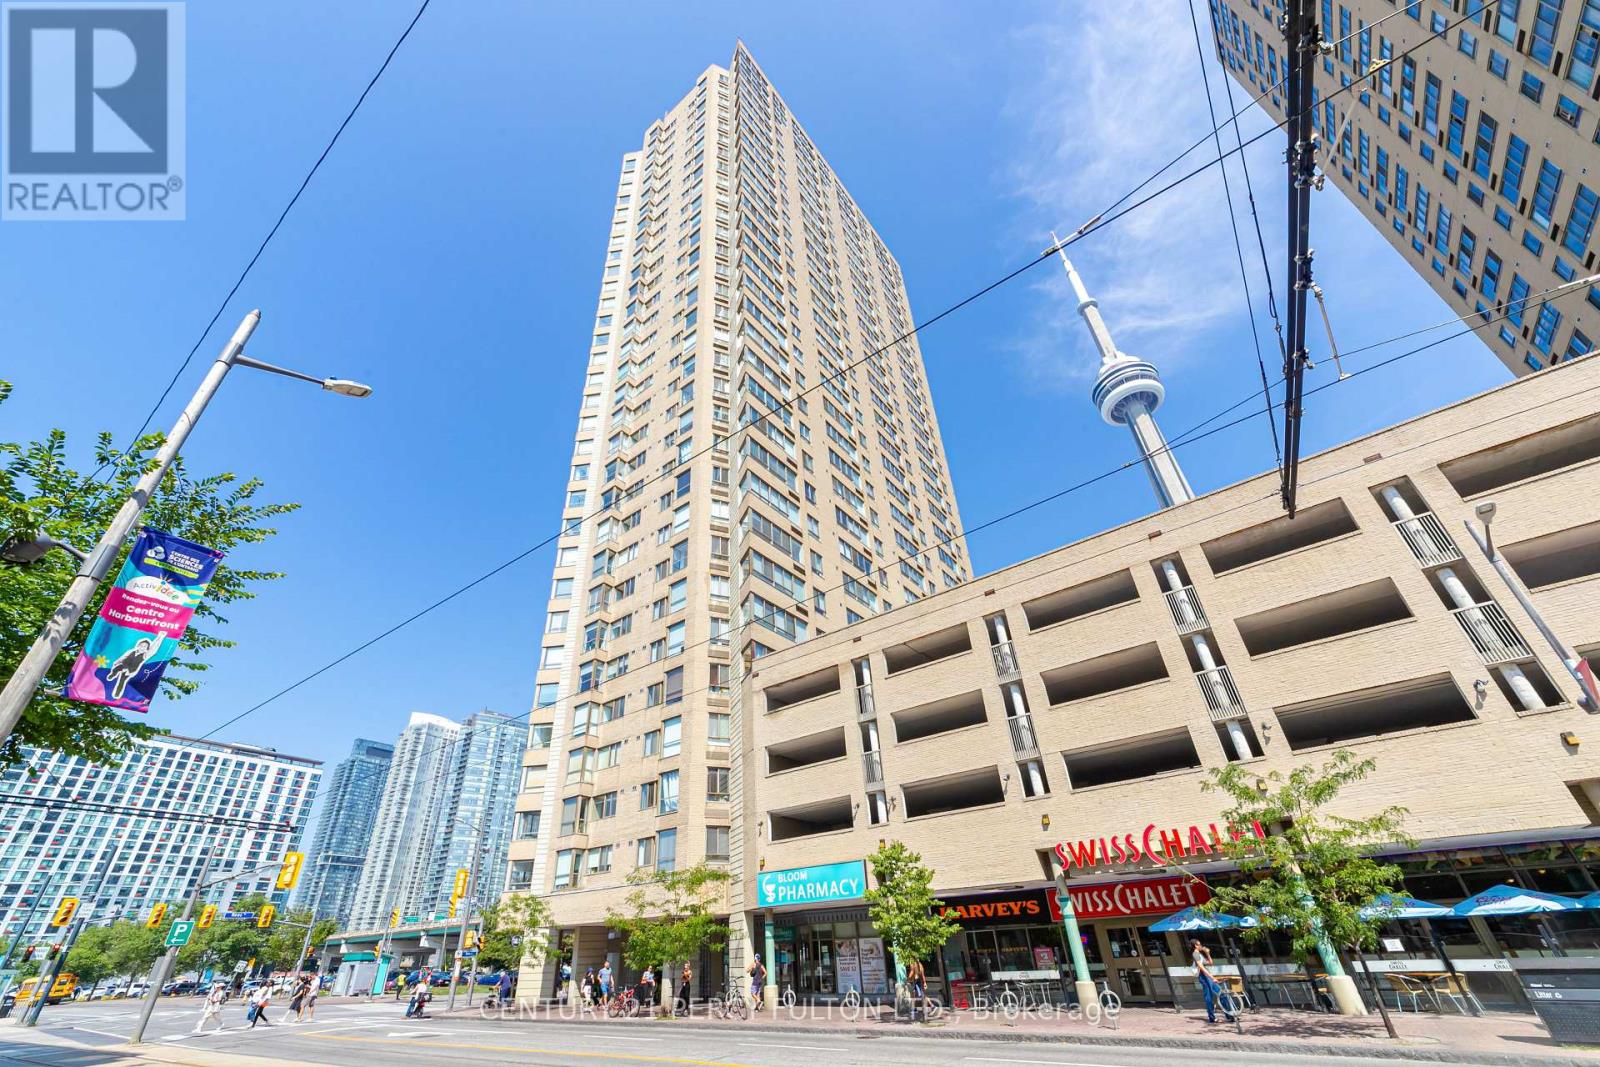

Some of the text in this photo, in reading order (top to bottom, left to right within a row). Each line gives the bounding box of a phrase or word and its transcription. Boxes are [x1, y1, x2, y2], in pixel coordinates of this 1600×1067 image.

[168, 554, 204, 570] SCIENCES
[126, 605, 165, 618] Centre
[108, 608, 180, 630] Harbourfront
[778, 871, 808, 883] BLOOM
[778, 877, 859, 901] PHARMACY
[174, 924, 188, 937] P
